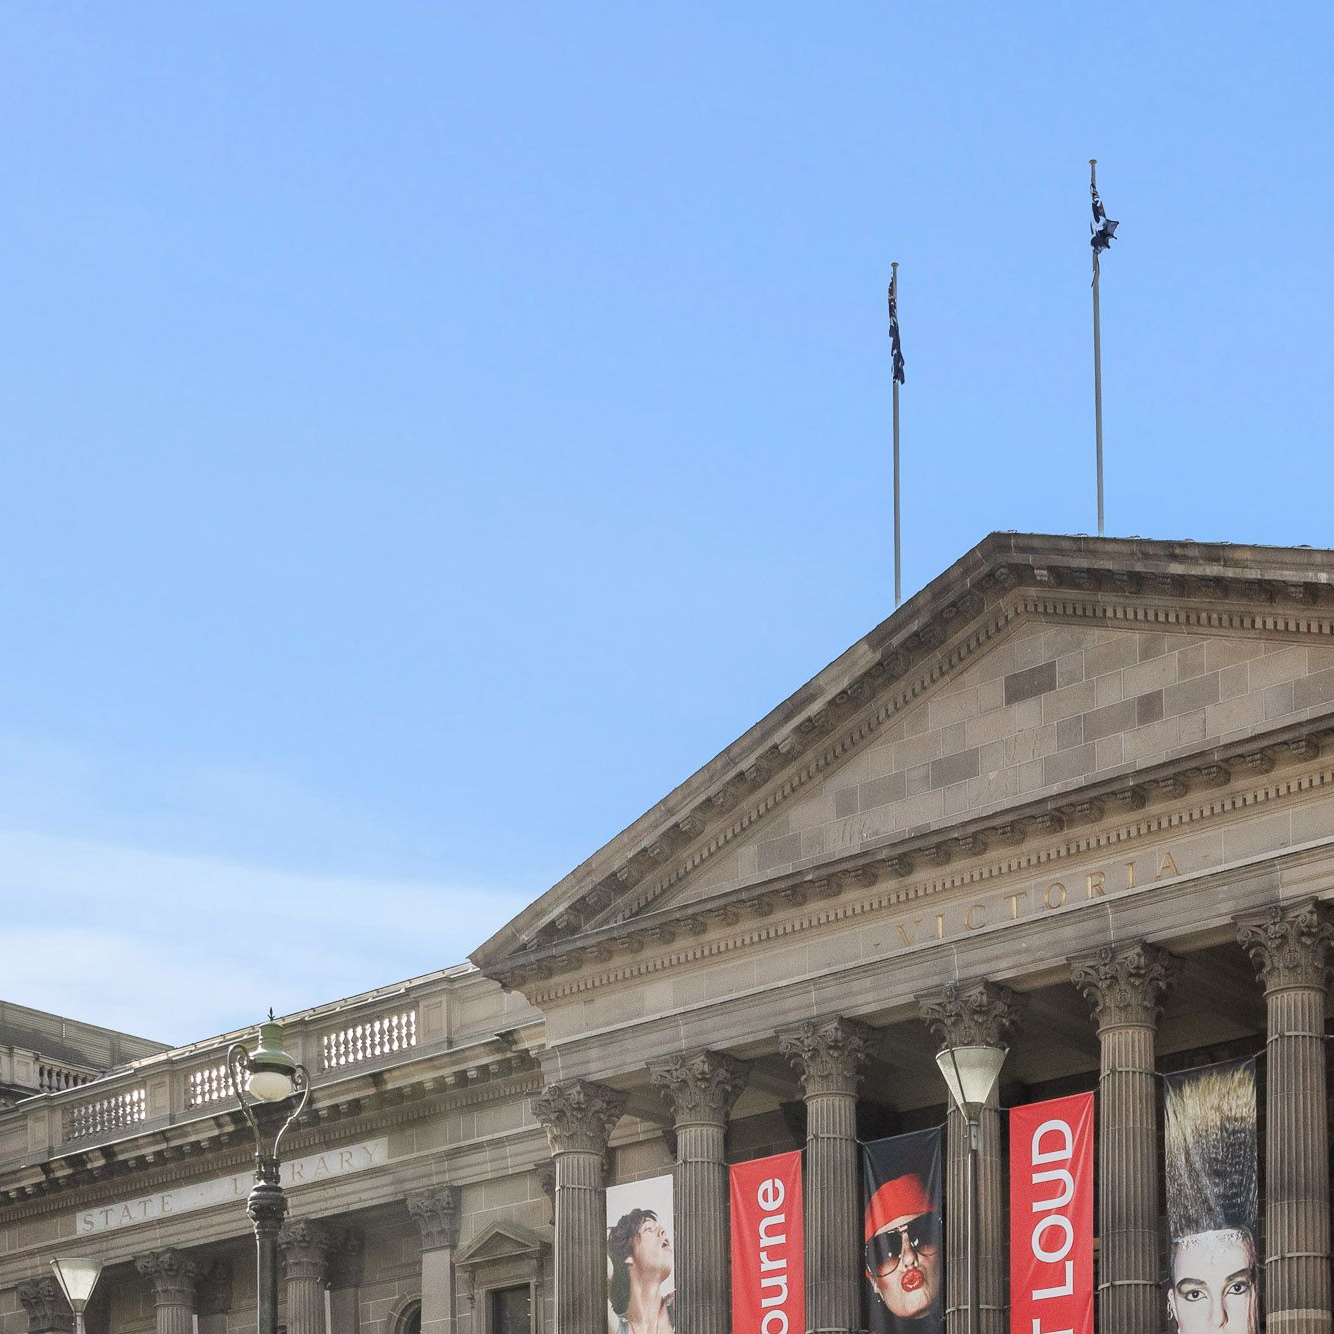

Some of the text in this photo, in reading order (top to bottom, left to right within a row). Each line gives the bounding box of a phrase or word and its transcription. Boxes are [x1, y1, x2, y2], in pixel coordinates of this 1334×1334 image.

[895, 851, 1181, 947] VICTORIA
[83, 1143, 380, 1232] STATE LIRARY
[1032, 1119, 1075, 1301] LOUD
